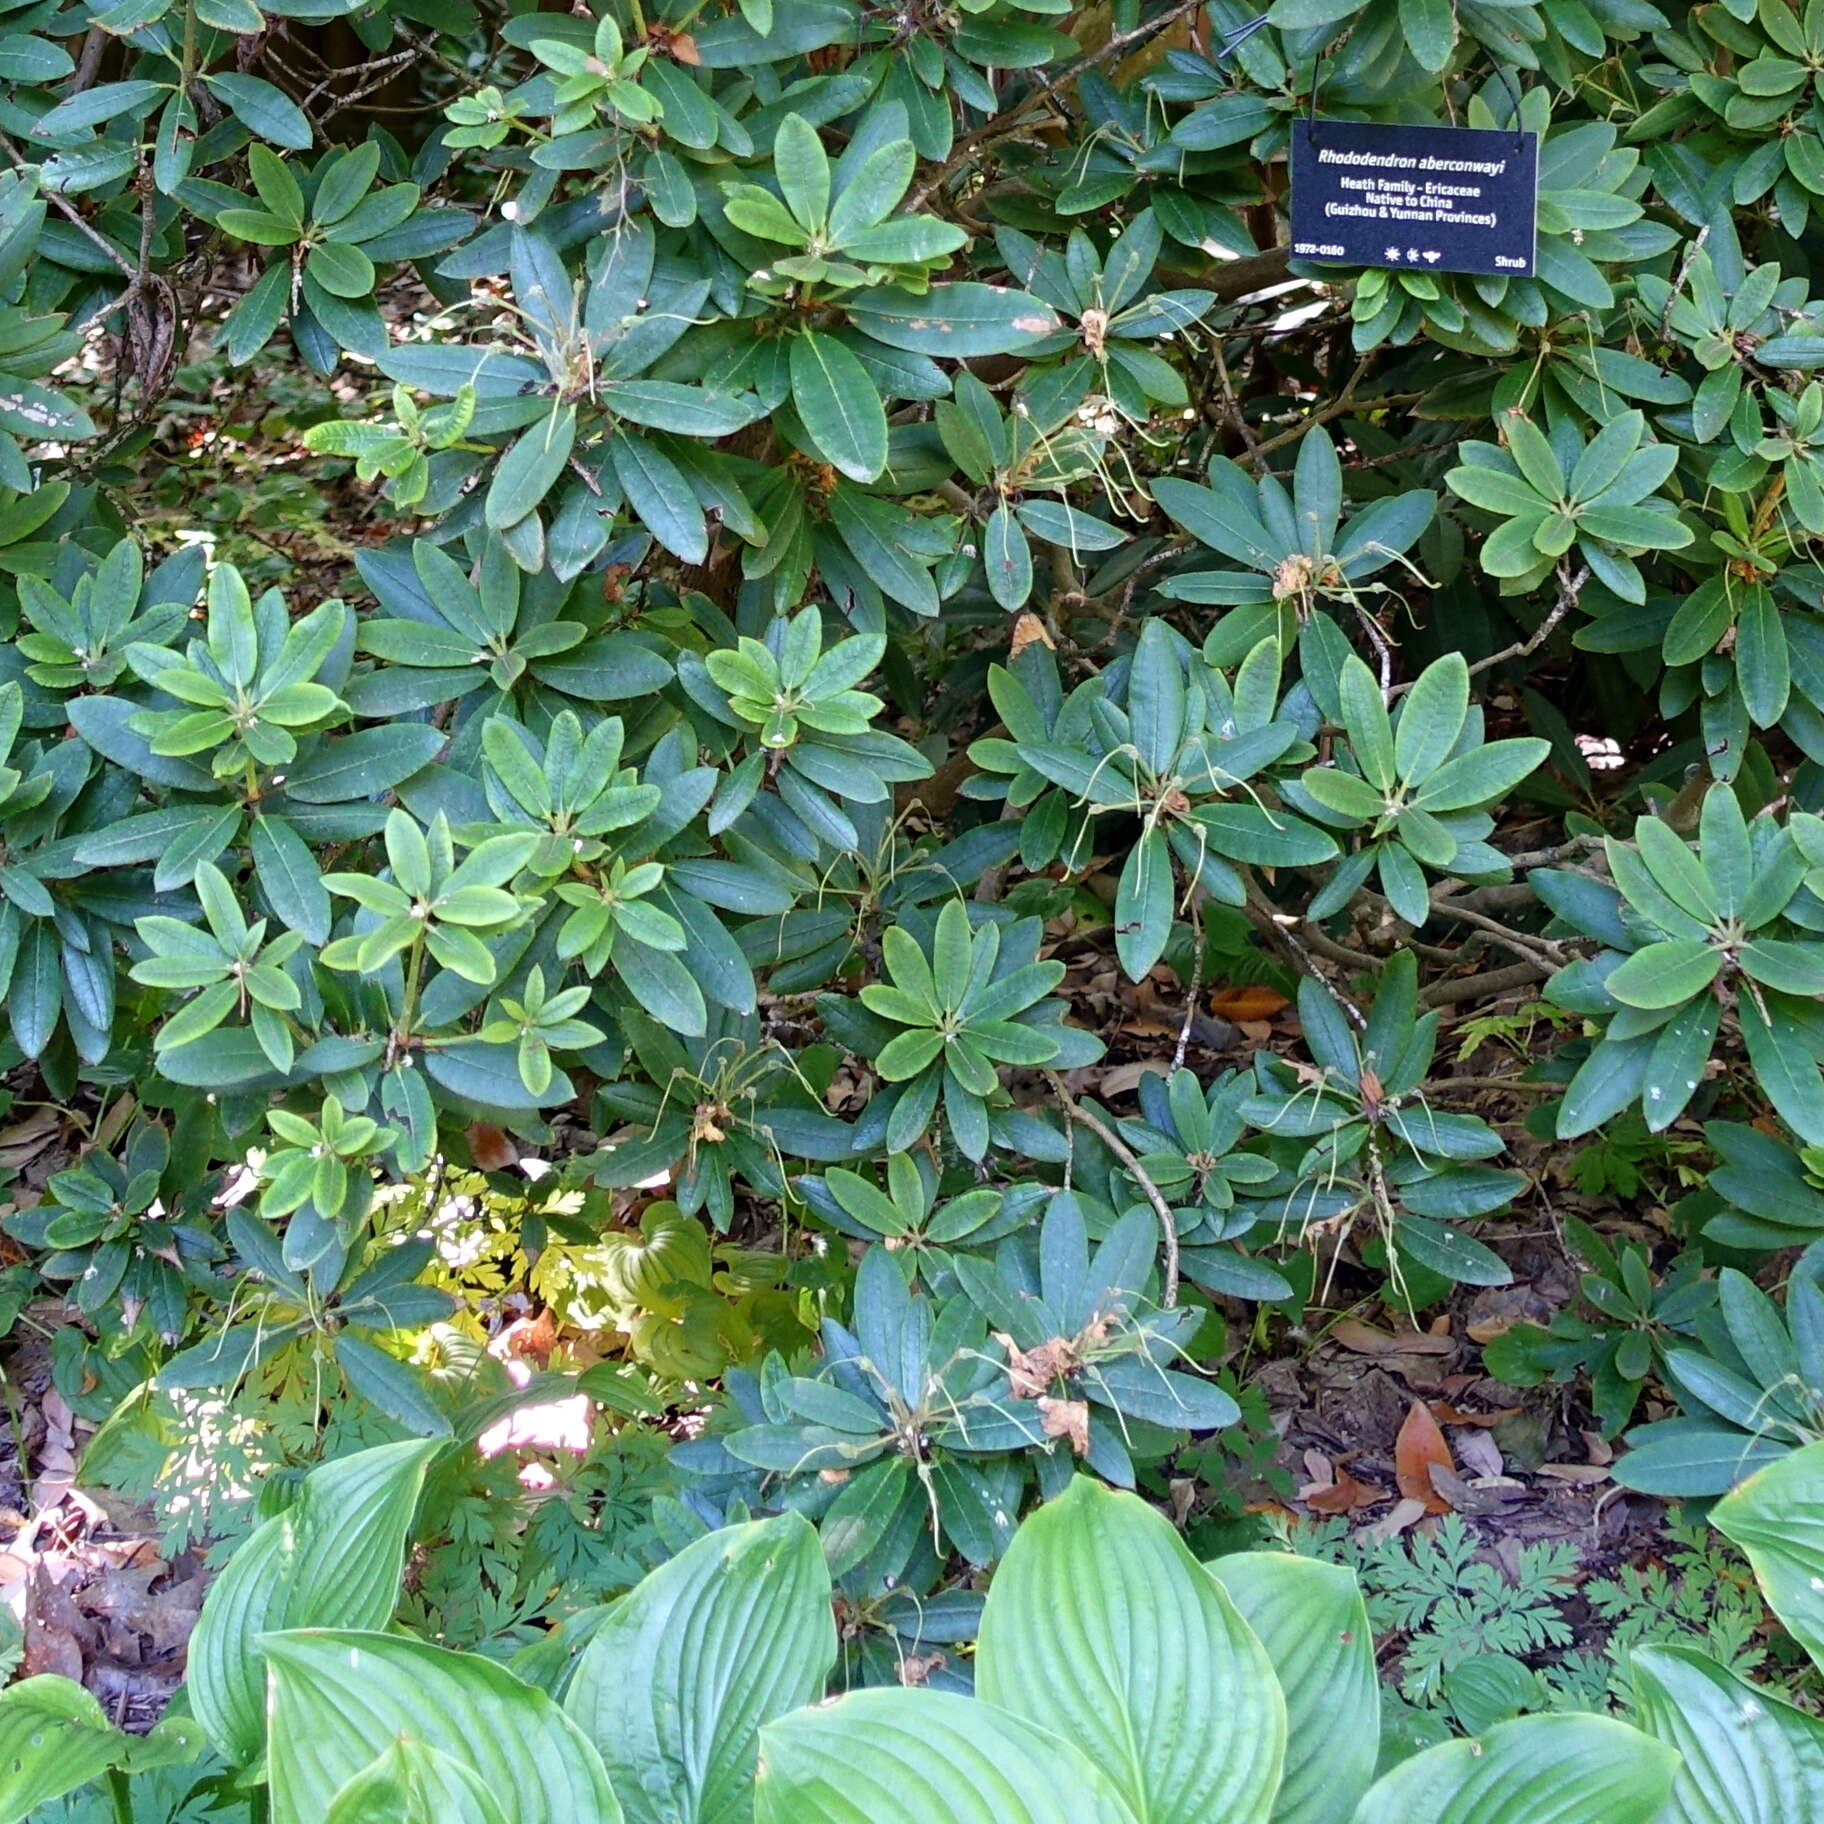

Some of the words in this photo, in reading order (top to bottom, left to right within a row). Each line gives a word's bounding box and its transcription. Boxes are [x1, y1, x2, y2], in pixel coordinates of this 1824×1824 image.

[1318, 149, 1416, 168] Rhododendron
[1419, 156, 1506, 176] aberconwayi
[1341, 177, 1375, 191] Heath
[1378, 179, 1415, 195] Family
[1425, 182, 1481, 197] Ericaceae
[1366, 192, 1404, 206] Native
[1405, 195, 1417, 207] to
[1420, 195, 1453, 209] China
[1325, 202, 1376, 218] (Guizhou
[1379, 206, 1388, 218] &
[1390, 207, 1433, 221] Yunnan
[1436, 210, 1497, 228] Provinces)
[1294, 243, 1345, 256] 1972-0160
[1495, 255, 1527, 268] Shrub
